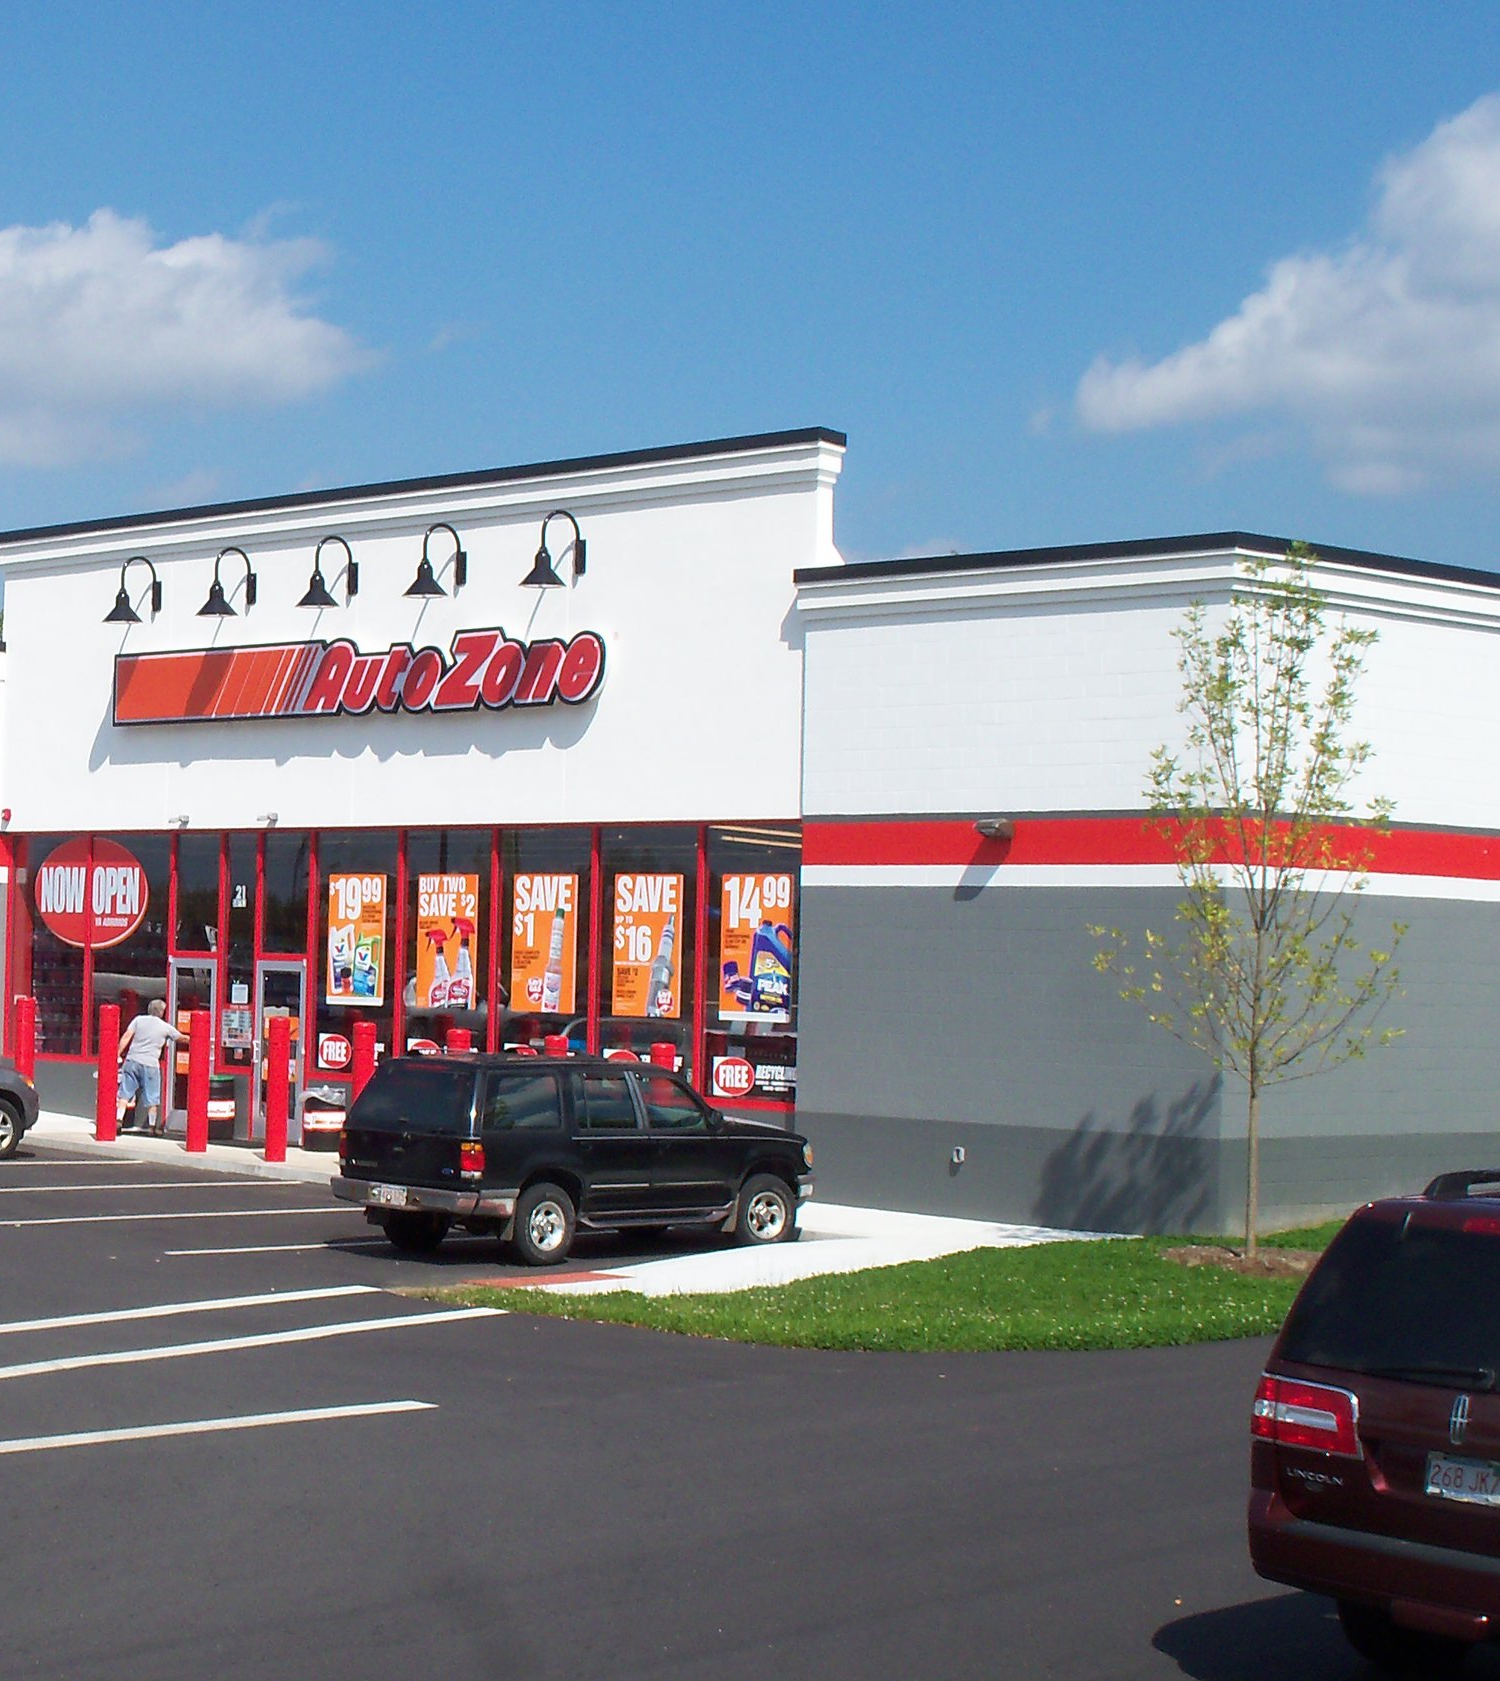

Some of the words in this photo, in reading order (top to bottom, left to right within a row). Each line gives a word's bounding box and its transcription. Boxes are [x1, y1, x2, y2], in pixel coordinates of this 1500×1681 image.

[301, 629, 606, 714] AutoZone
[41, 866, 87, 914] NOW
[92, 866, 141, 916] OPEN
[235, 885, 247, 901] 21
[420, 877, 440, 893] BUY
[442, 877, 466, 893] TWO
[515, 875, 572, 912] SAVE
[616, 875, 677, 913] SAVE
[419, 894, 457, 917] SAVE
[460, 894, 475, 917] $2
[514, 912, 535, 948] $1
[614, 925, 652, 962] $16
[757, 978, 789, 996] PEAK
[323, 1040, 347, 1062] FREE
[719, 1064, 749, 1089] FREE
[1286, 1466, 1345, 1487] LINCOLN
[1430, 1463, 1464, 1489] 268
